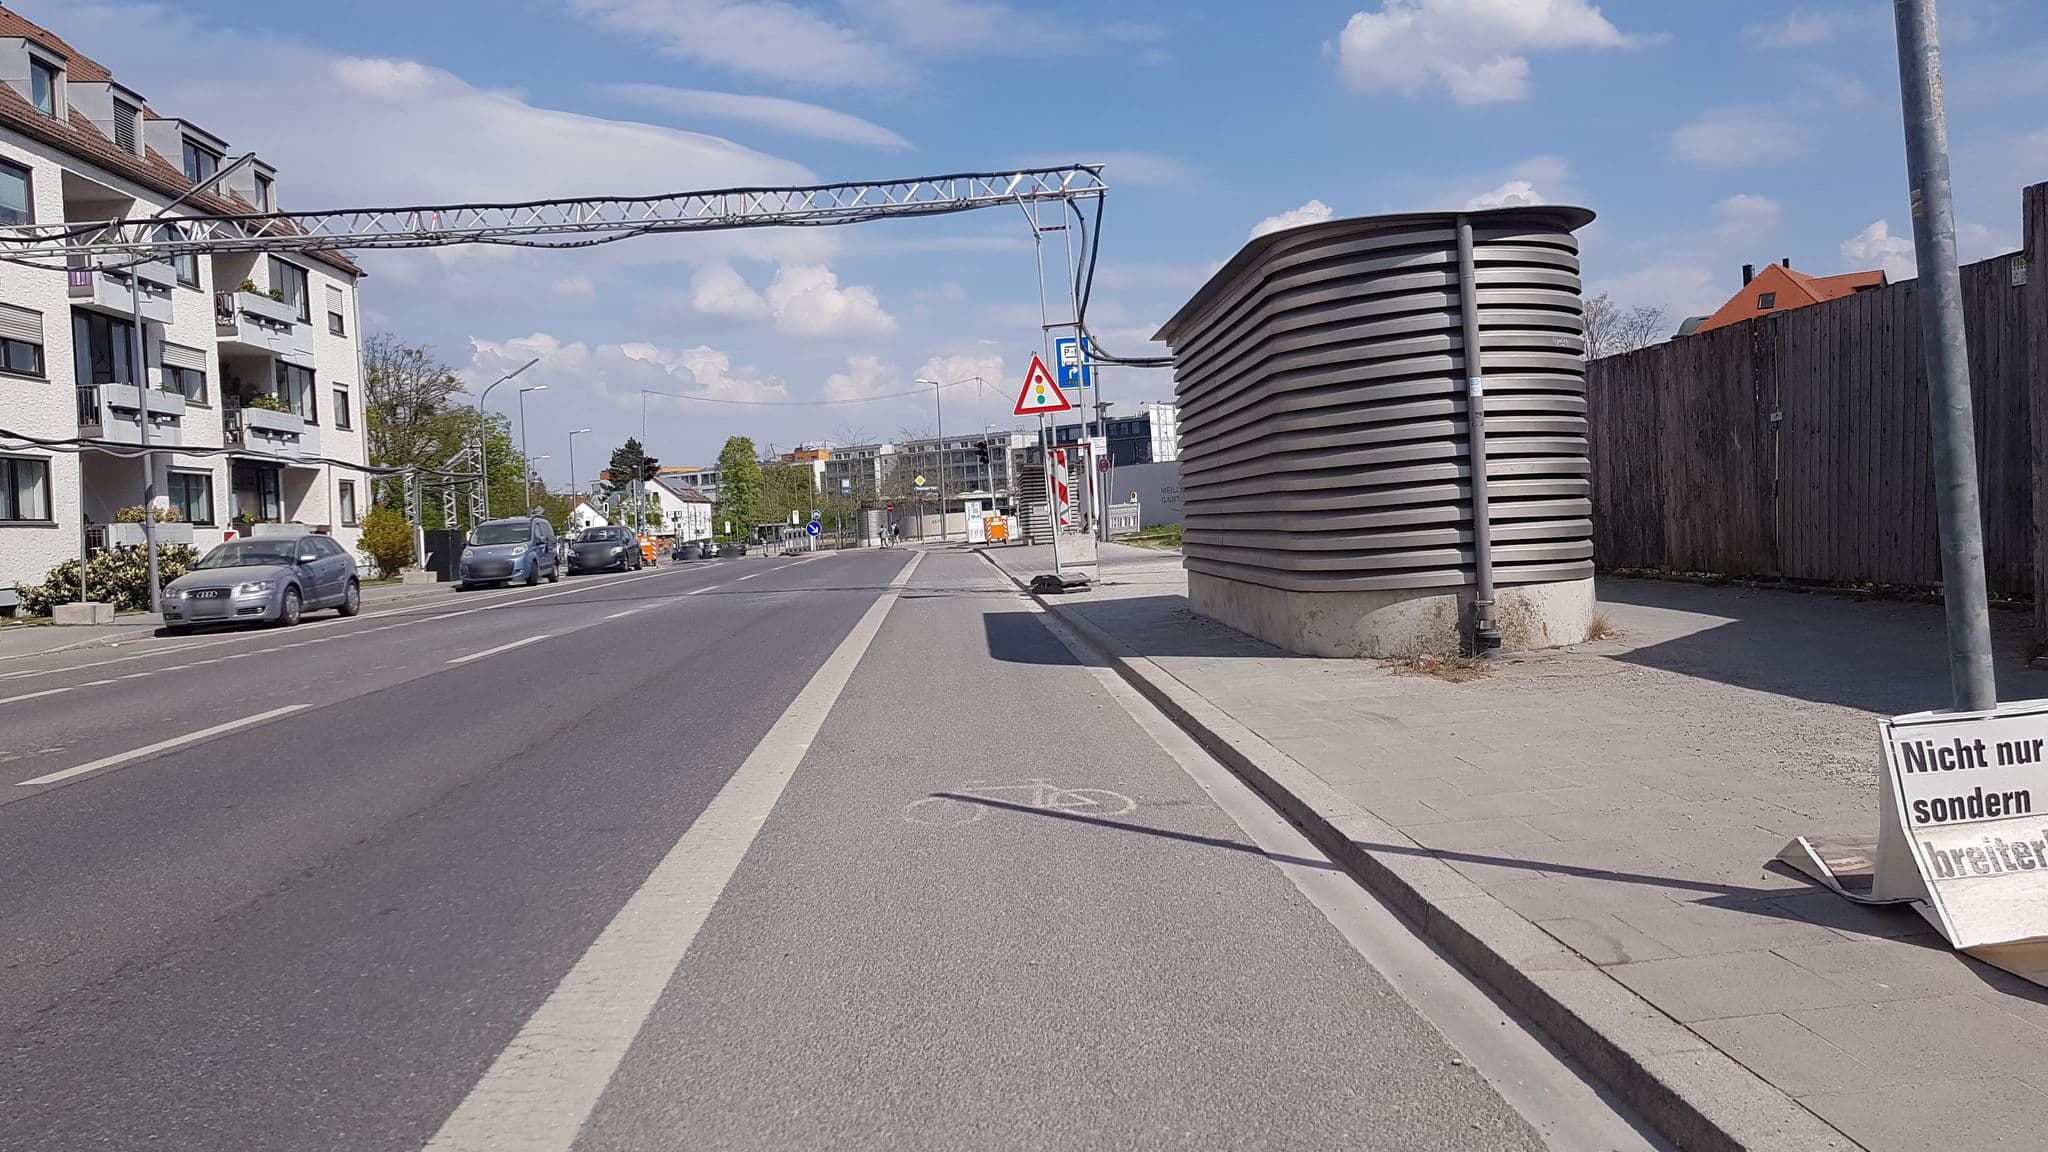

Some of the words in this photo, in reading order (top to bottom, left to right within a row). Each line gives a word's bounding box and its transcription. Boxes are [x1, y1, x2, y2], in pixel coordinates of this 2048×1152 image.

[1901, 738, 1988, 773] Nicht
[1996, 739, 2044, 766] nur
[1913, 787, 2031, 824] sondern
